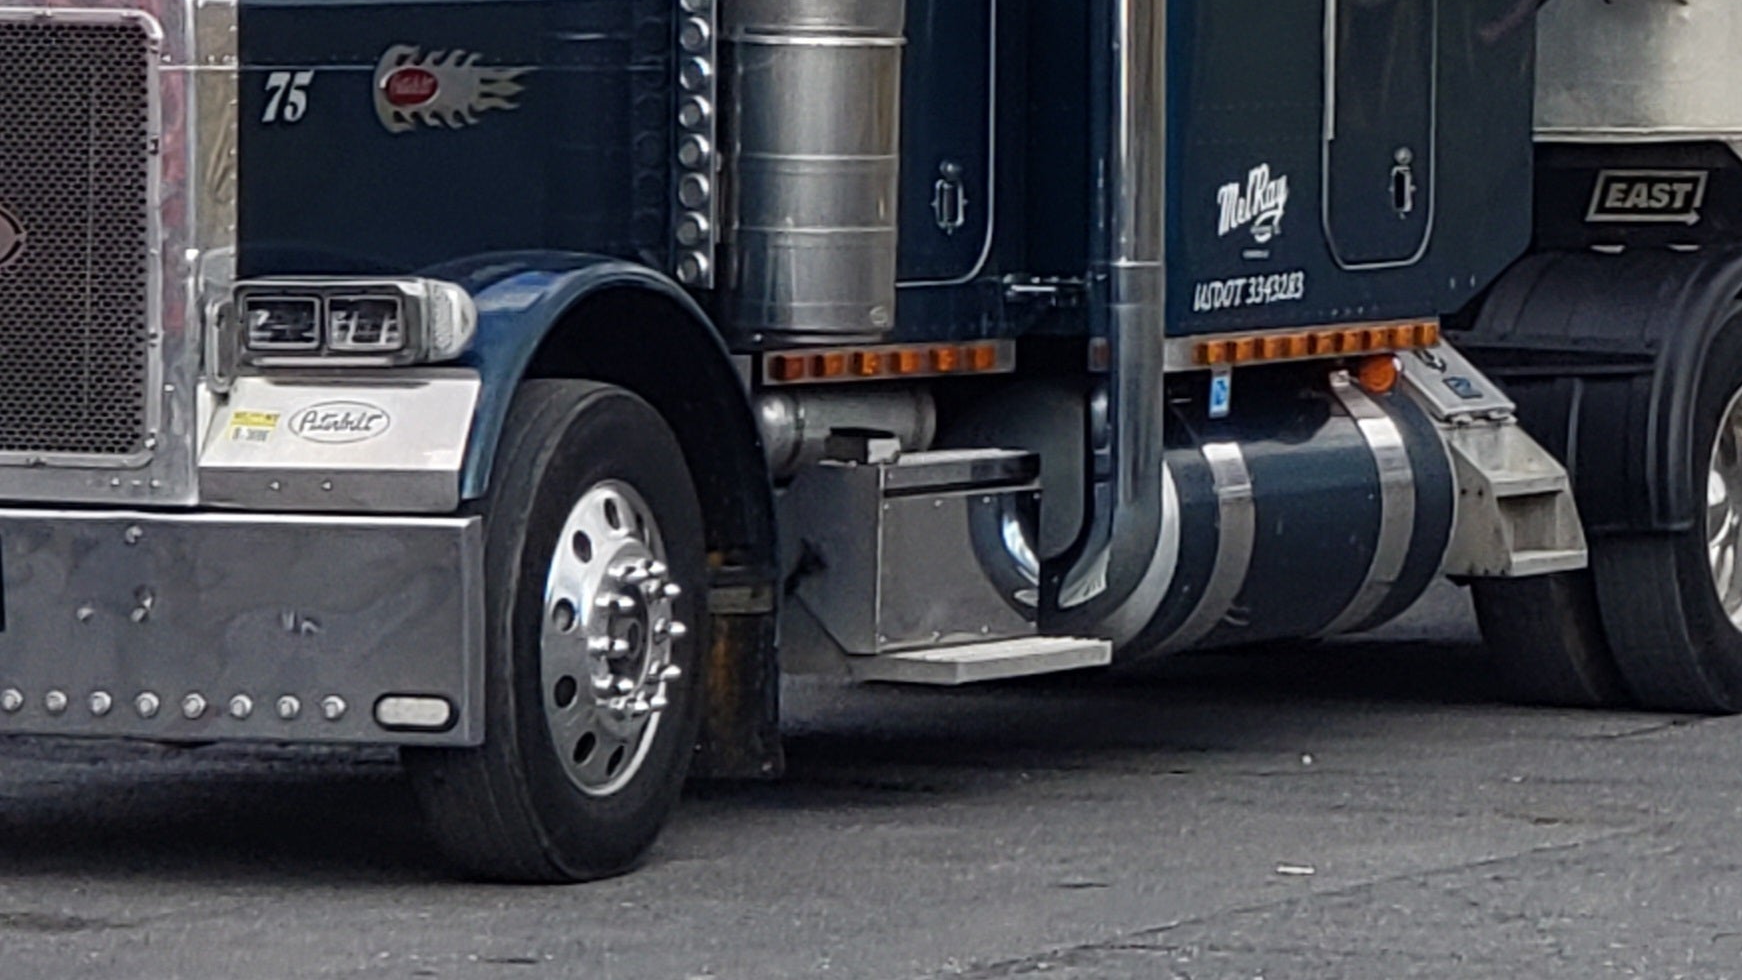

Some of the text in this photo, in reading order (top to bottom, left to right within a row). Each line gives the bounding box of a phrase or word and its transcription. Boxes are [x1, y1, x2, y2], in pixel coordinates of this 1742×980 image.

[261, 69, 315, 123] 75
[1604, 182, 1694, 209] EAST
[1193, 277, 1248, 312] USDOT
